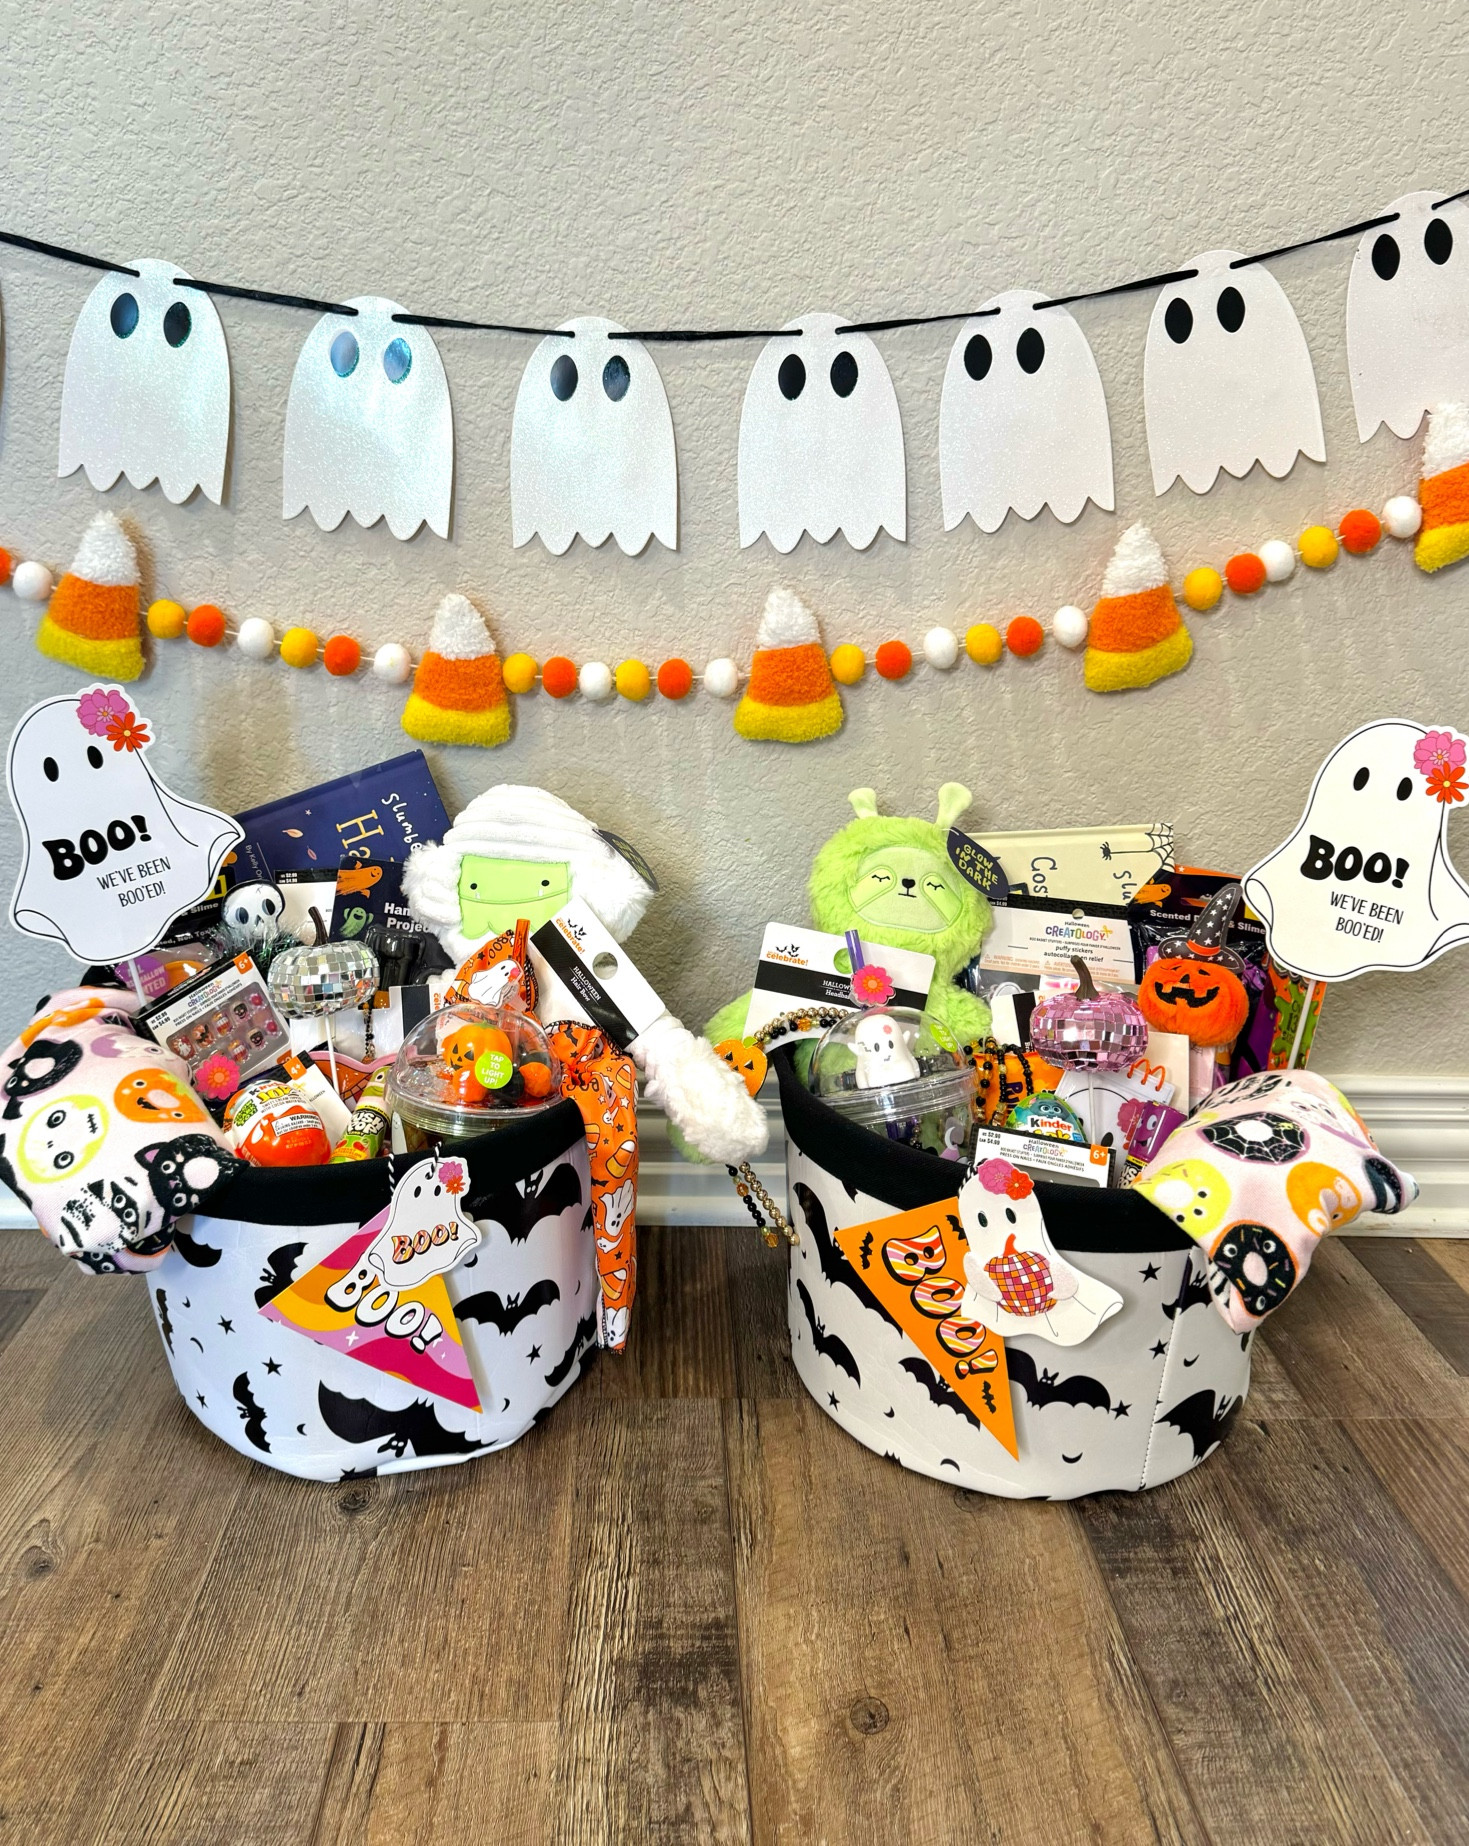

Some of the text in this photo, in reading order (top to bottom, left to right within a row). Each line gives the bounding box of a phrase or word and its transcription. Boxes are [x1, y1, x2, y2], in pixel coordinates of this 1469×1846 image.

[42, 814, 152, 881] BOO!
[963, 844, 994, 870] GLOW
[955, 847, 998, 886] IN THE
[1300, 834, 1410, 889] BOO!
[96, 856, 171, 890] WE'VE BEEN
[958, 858, 992, 892] DARK
[117, 881, 166, 908] BOO'ED!
[190, 902, 219, 914] Slime
[1149, 909, 1191, 922] Scented
[1330, 890, 1405, 925] WE'VE BEEN
[1045, 925, 1106, 942] CREATOLOGY
[1064, 920, 1091, 929] Halloween
[1335, 916, 1385, 943] BOO'ED!
[555, 917, 586, 955] celebrate!
[765, 950, 809, 967] celebrate!
[1043, 951, 1072, 959] autocolla
[1055, 945, 1094, 955] puffy stickers
[570, 977, 591, 1001] Hair Bow
[573, 965, 602, 1001] HALLOWEEN
[490, 1053, 505, 1063] TAP
[490, 1061, 501, 1070] TO
[481, 1067, 505, 1079] LIGHT
[484, 1076, 498, 1086] UP!
[1029, 1117, 1073, 1133] Kinder
[1022, 1144, 1063, 1157] CREATOLOGY
[1028, 1139, 1060, 1149] Halloween
[1092, 1149, 1107, 1160] 6+
[391, 1221, 460, 1265] BOO!
[323, 1254, 444, 1356] BOO!
[881, 1224, 999, 1380] BOO!
